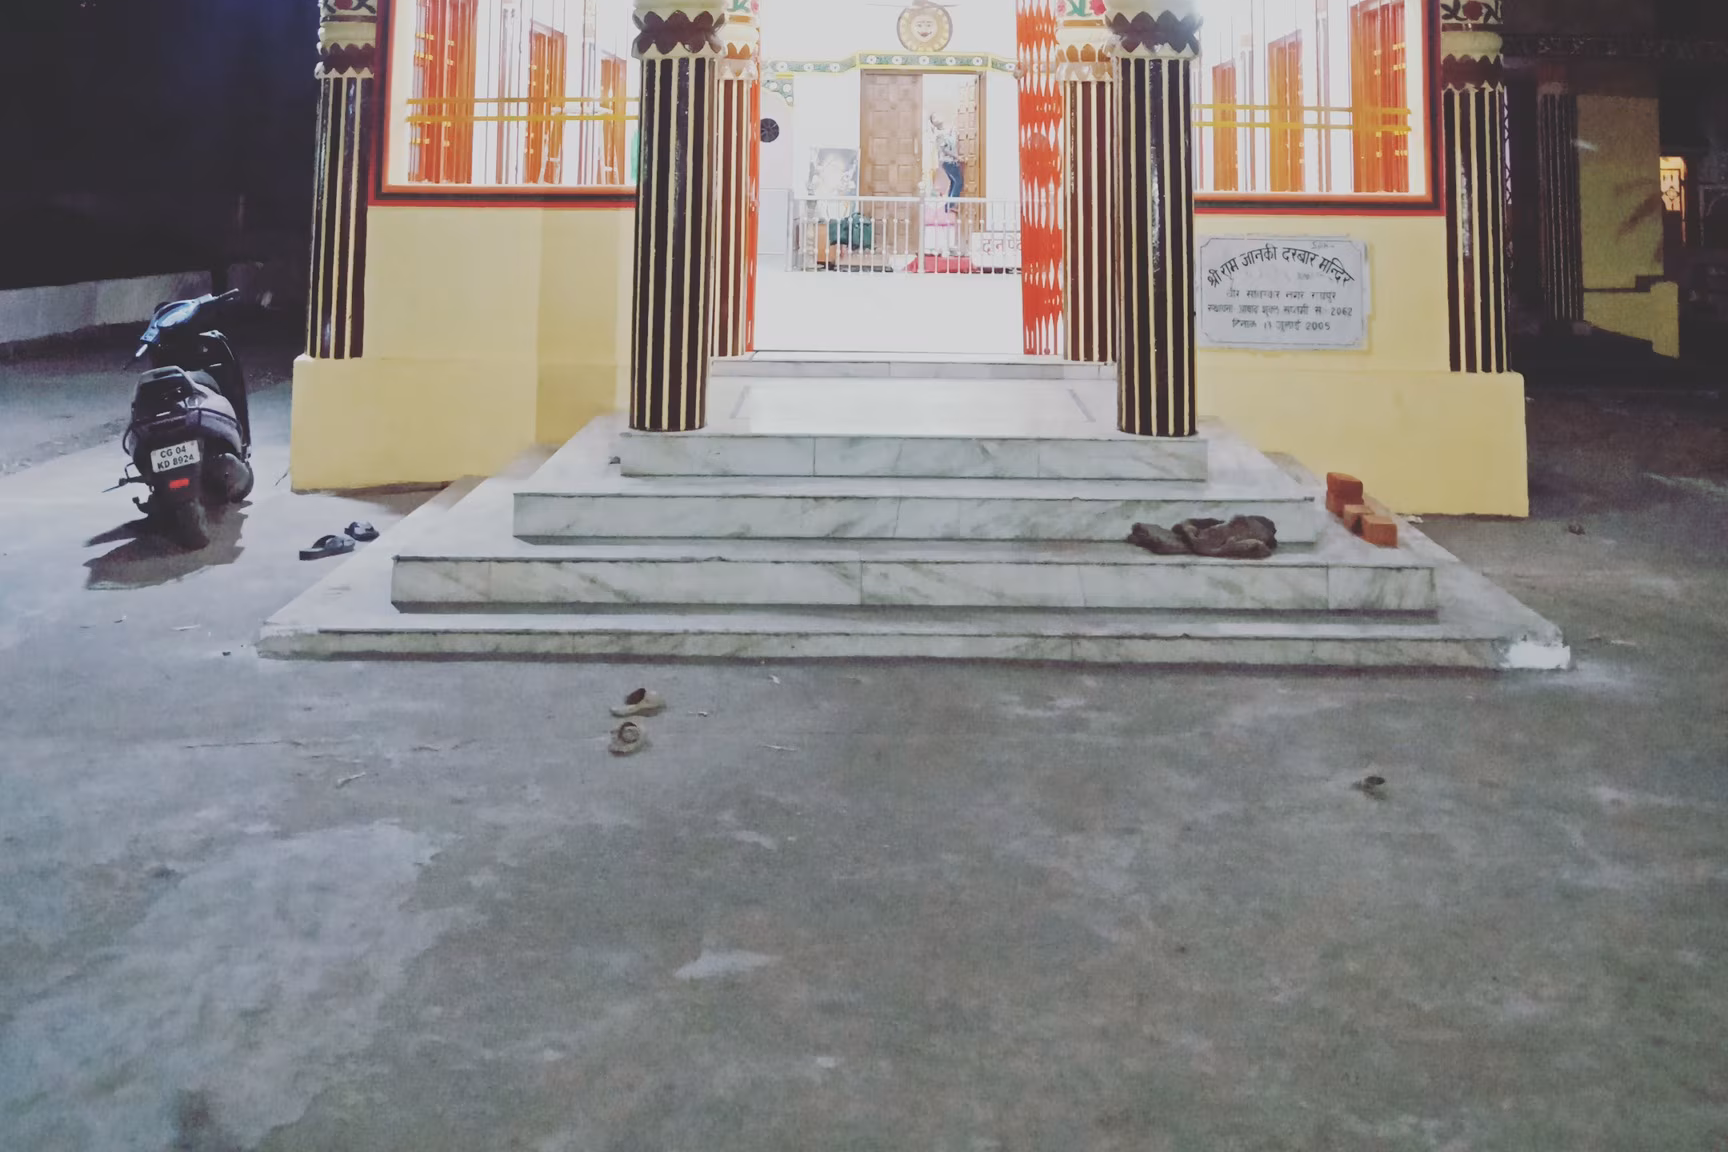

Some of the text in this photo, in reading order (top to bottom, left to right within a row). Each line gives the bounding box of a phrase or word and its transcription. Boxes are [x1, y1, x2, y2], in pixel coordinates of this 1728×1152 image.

[1207, 267, 1222, 288] श्री
[1220, 257, 1239, 278] राम
[1240, 243, 1278, 267] जानकी
[1282, 247, 1319, 267] दरबार
[1319, 257, 1355, 286] मन्दिर
[1330, 306, 1353, 317] 2062
[1305, 321, 1331, 331] 2005
[160, 445, 186, 459] CG 04
[157, 454, 194, 470] KD 8924
